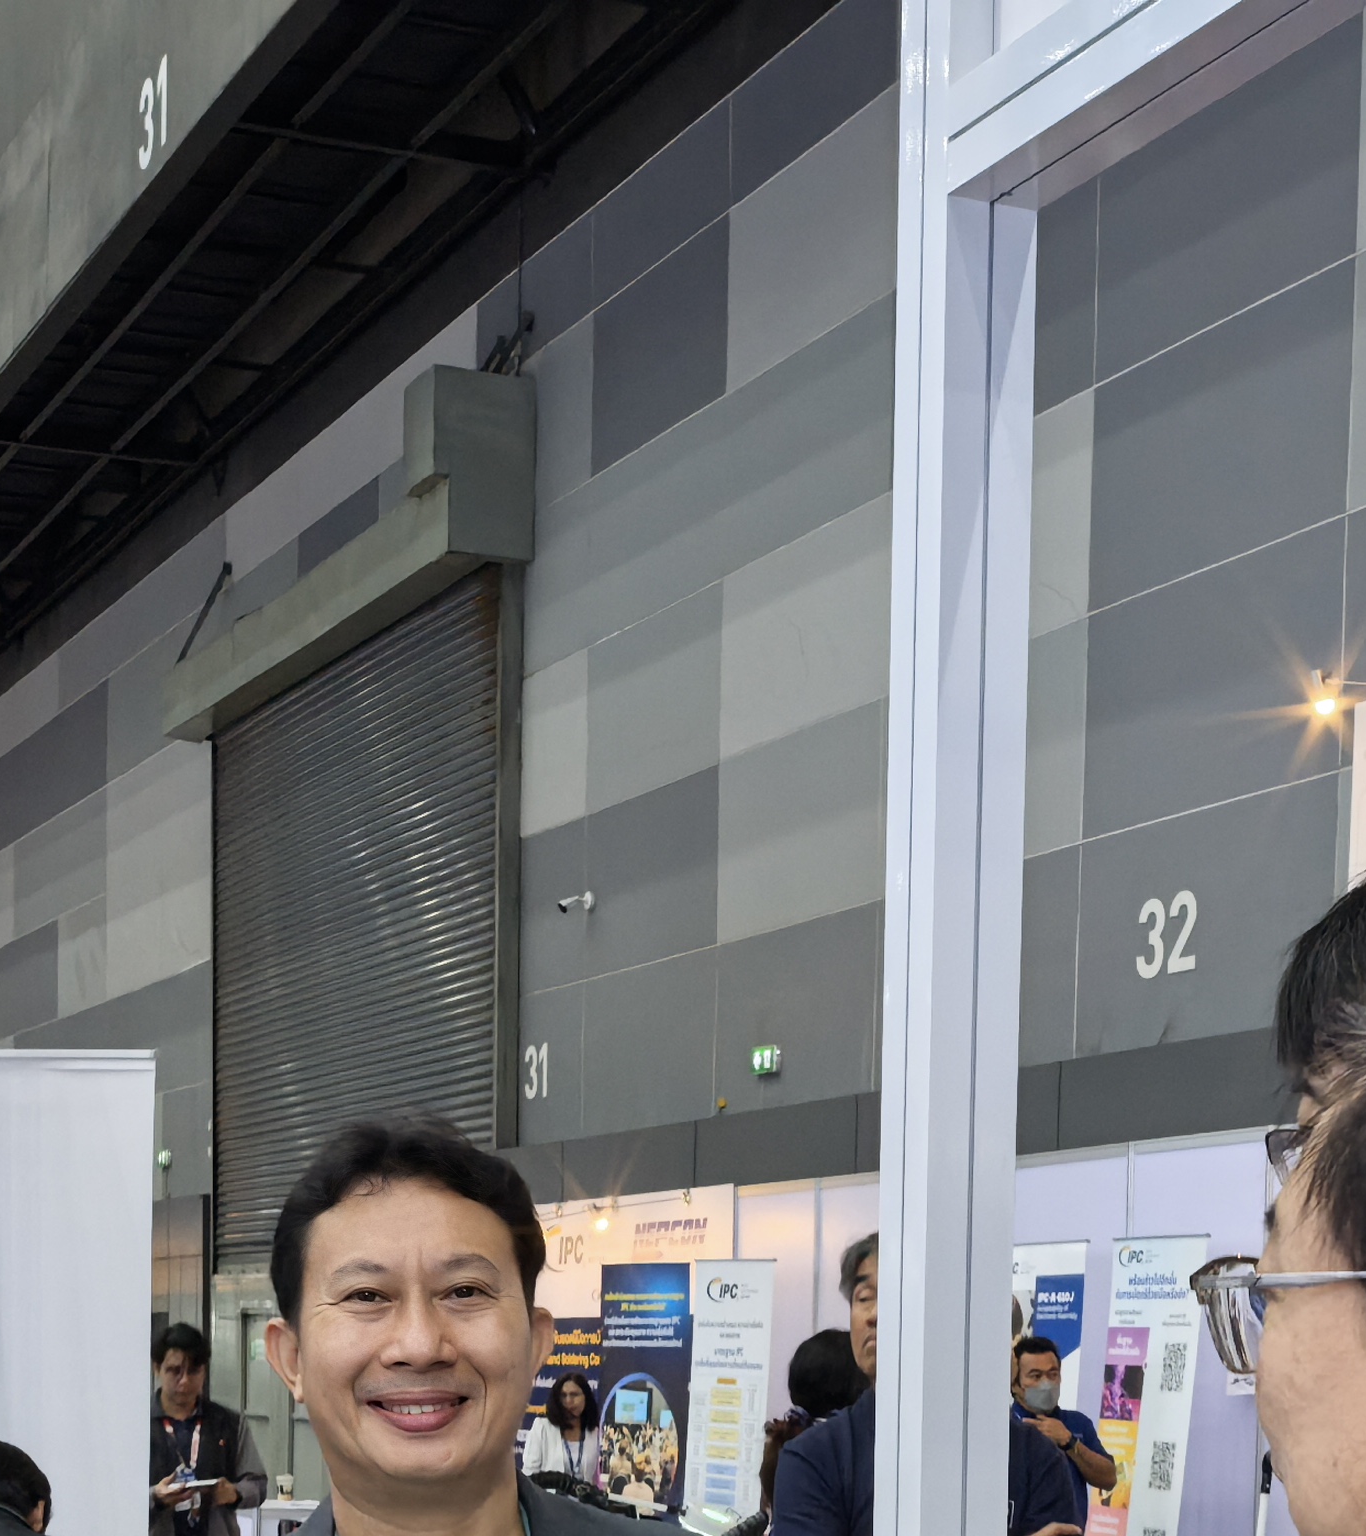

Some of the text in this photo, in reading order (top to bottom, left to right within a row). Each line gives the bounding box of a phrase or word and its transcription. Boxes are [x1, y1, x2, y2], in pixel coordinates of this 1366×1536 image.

[138, 53, 167, 170] 31
[1136, 891, 1197, 979] 32
[524, 1042, 549, 1100] 31
[558, 1234, 584, 1265] IPC
[719, 1283, 739, 1299] IPC
